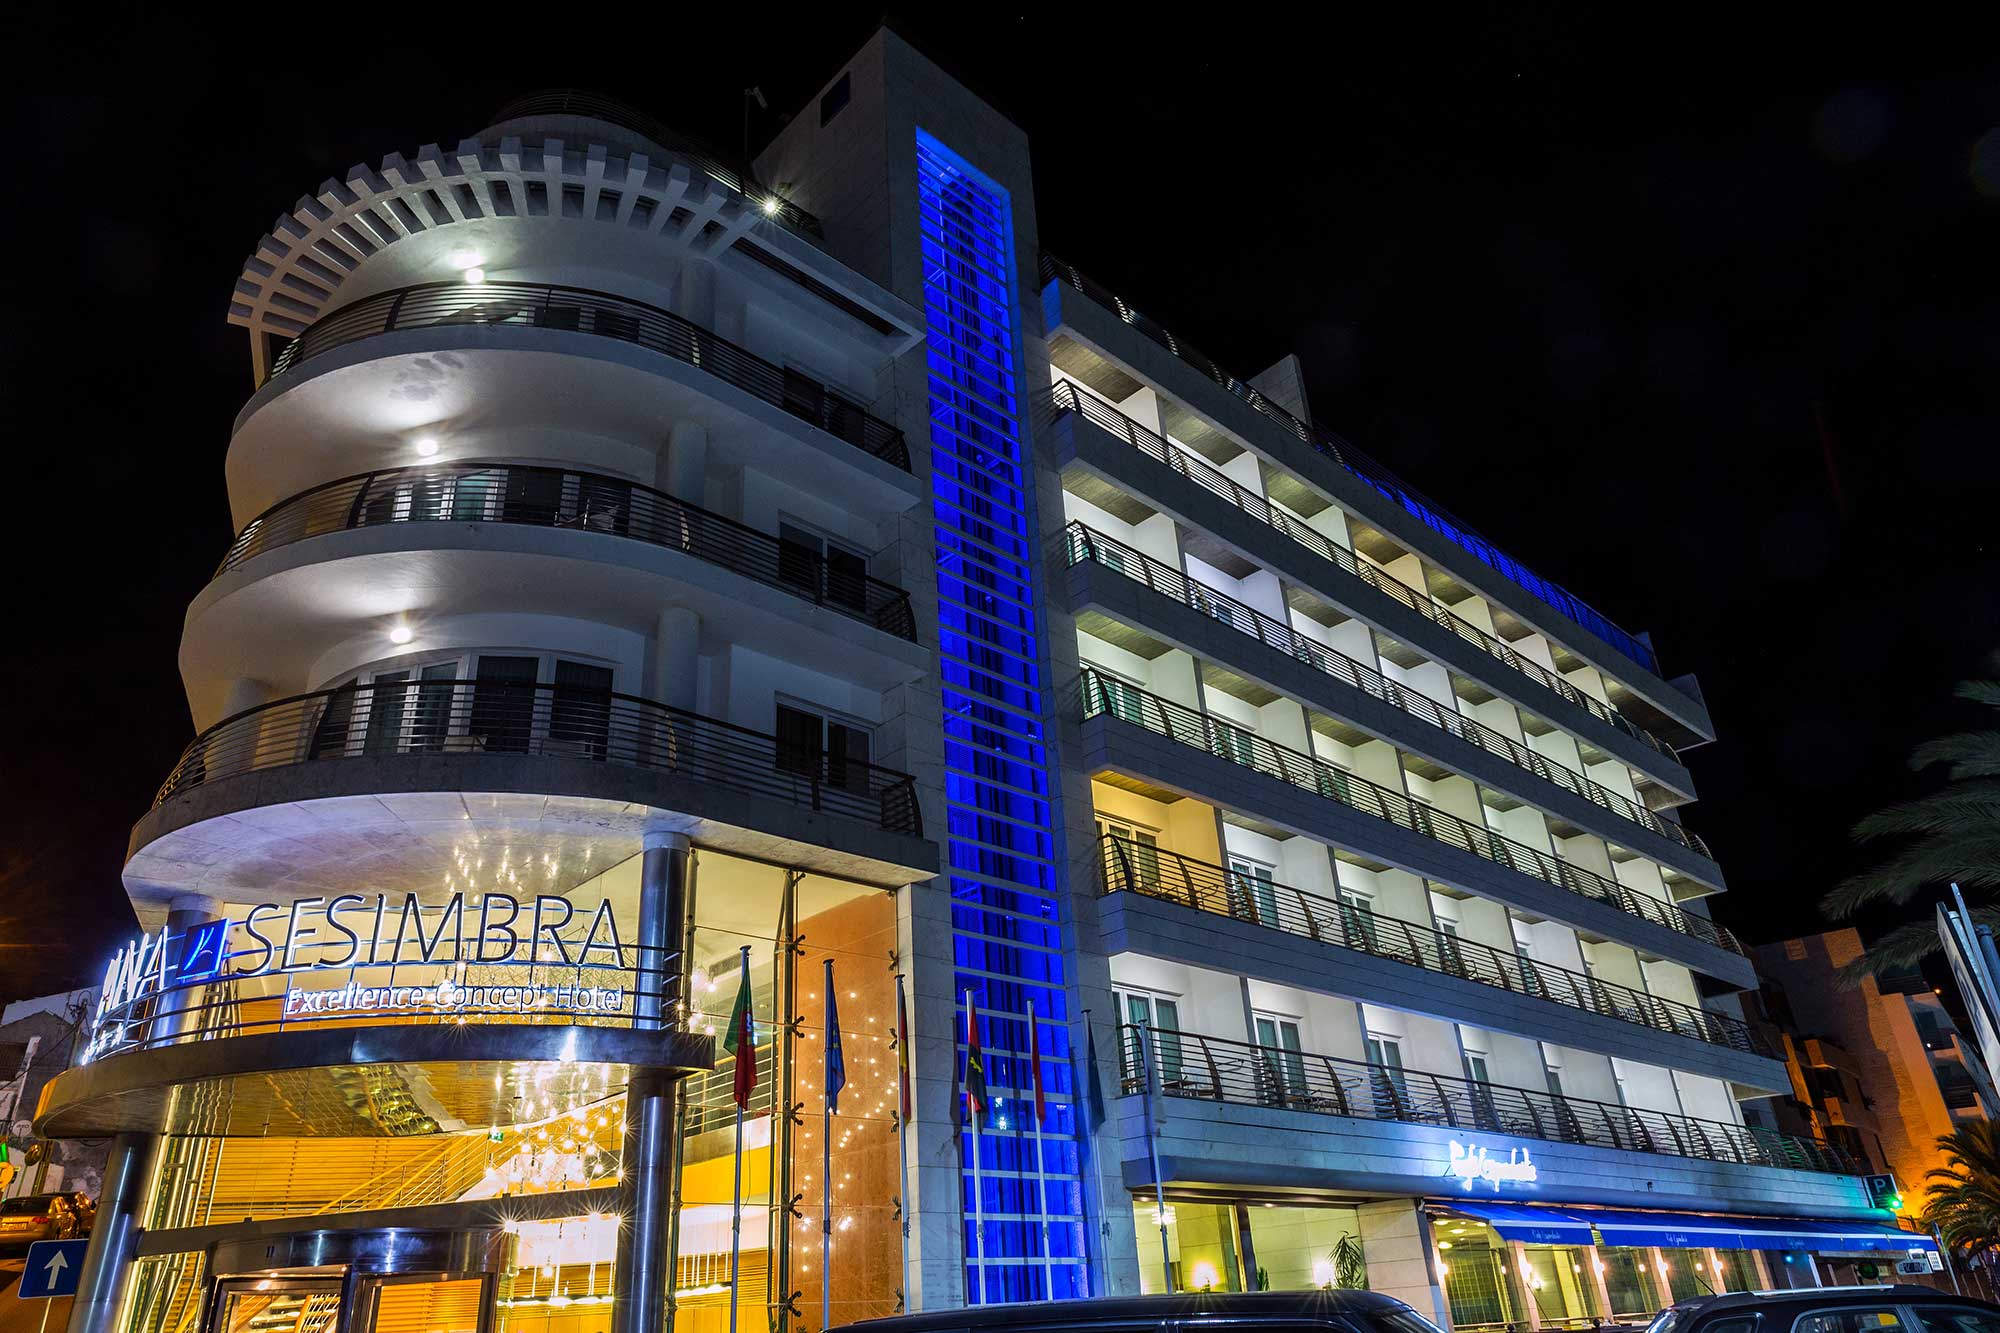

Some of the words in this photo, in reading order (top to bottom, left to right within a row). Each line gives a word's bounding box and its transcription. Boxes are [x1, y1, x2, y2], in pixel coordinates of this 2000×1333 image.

[235, 892, 626, 976] SESIMBRA
[285, 982, 424, 1015] Excellence
[435, 979, 547, 1012] Concept
[556, 984, 624, 1011] Hotel
[1873, 1178, 1886, 1193] P
